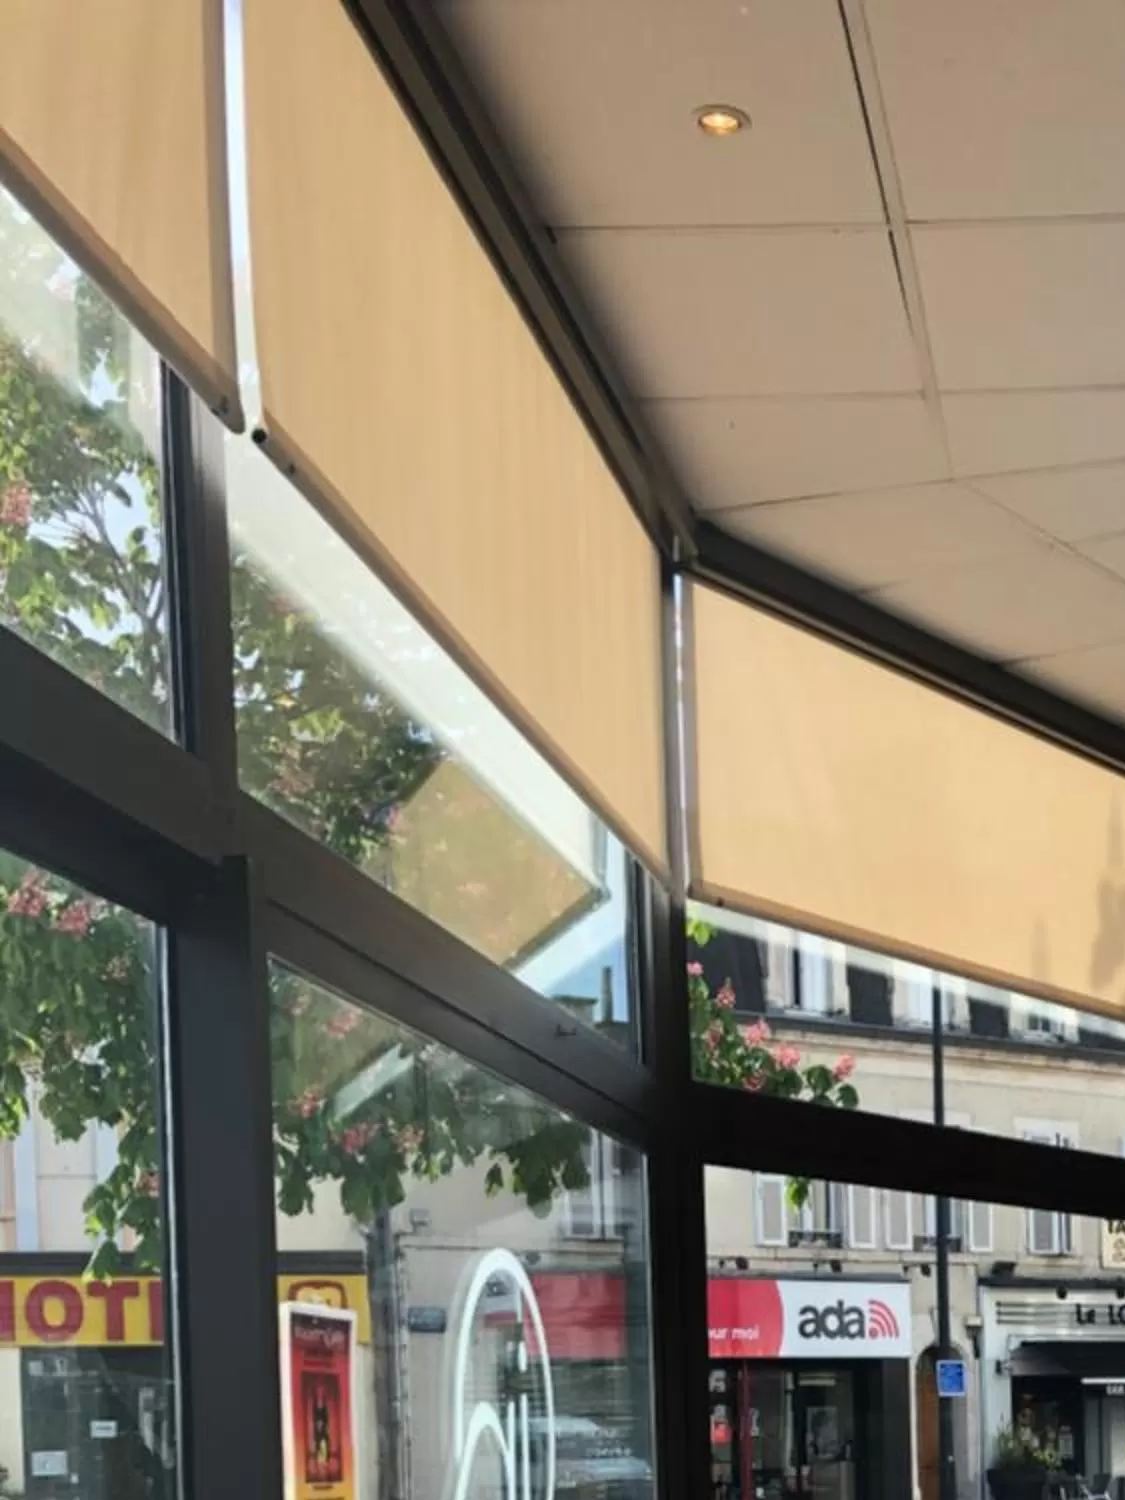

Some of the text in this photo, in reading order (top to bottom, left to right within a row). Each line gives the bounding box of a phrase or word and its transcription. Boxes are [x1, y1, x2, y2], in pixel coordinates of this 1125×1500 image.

[798, 1300, 865, 1340] ada
[1076, 1303, 1096, 1326] Le
[731, 1325, 760, 1340] moi
